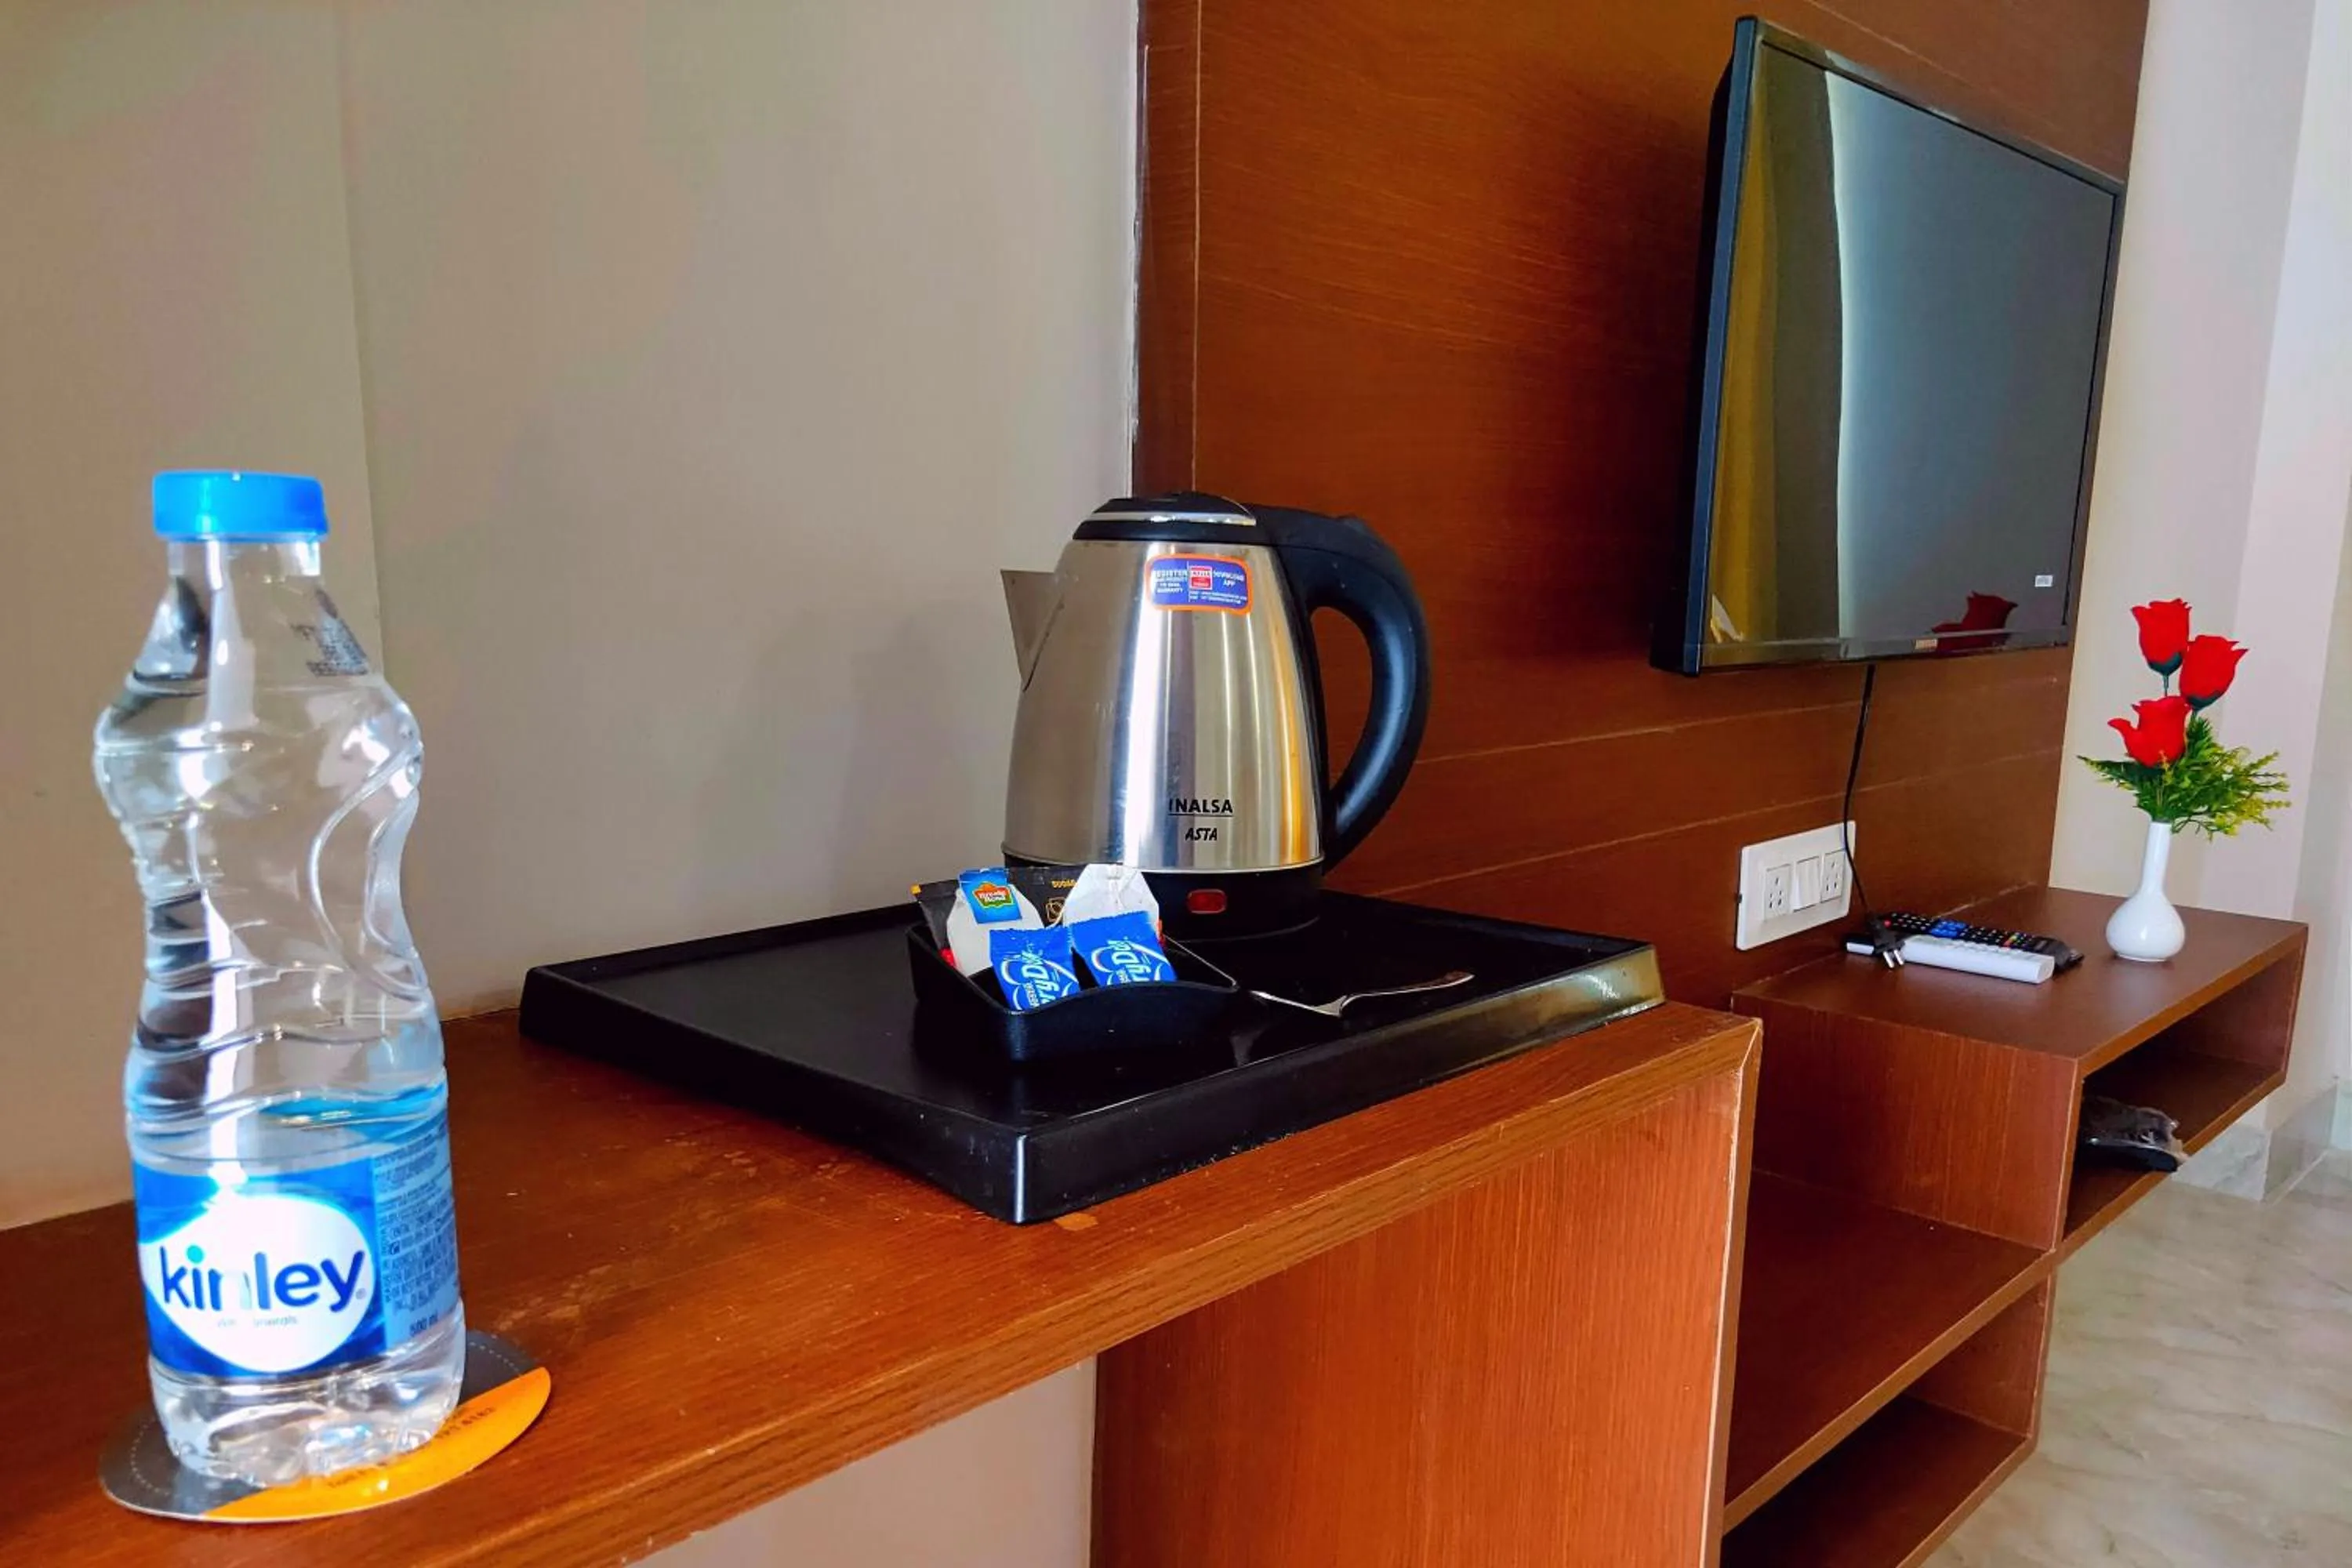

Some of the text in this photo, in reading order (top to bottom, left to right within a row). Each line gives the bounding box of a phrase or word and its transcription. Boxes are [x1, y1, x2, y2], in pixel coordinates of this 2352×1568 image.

[1169, 799, 1233, 814] INALSA
[1185, 827, 1218, 841] ASTA
[159, 1245, 365, 1312] kinley
